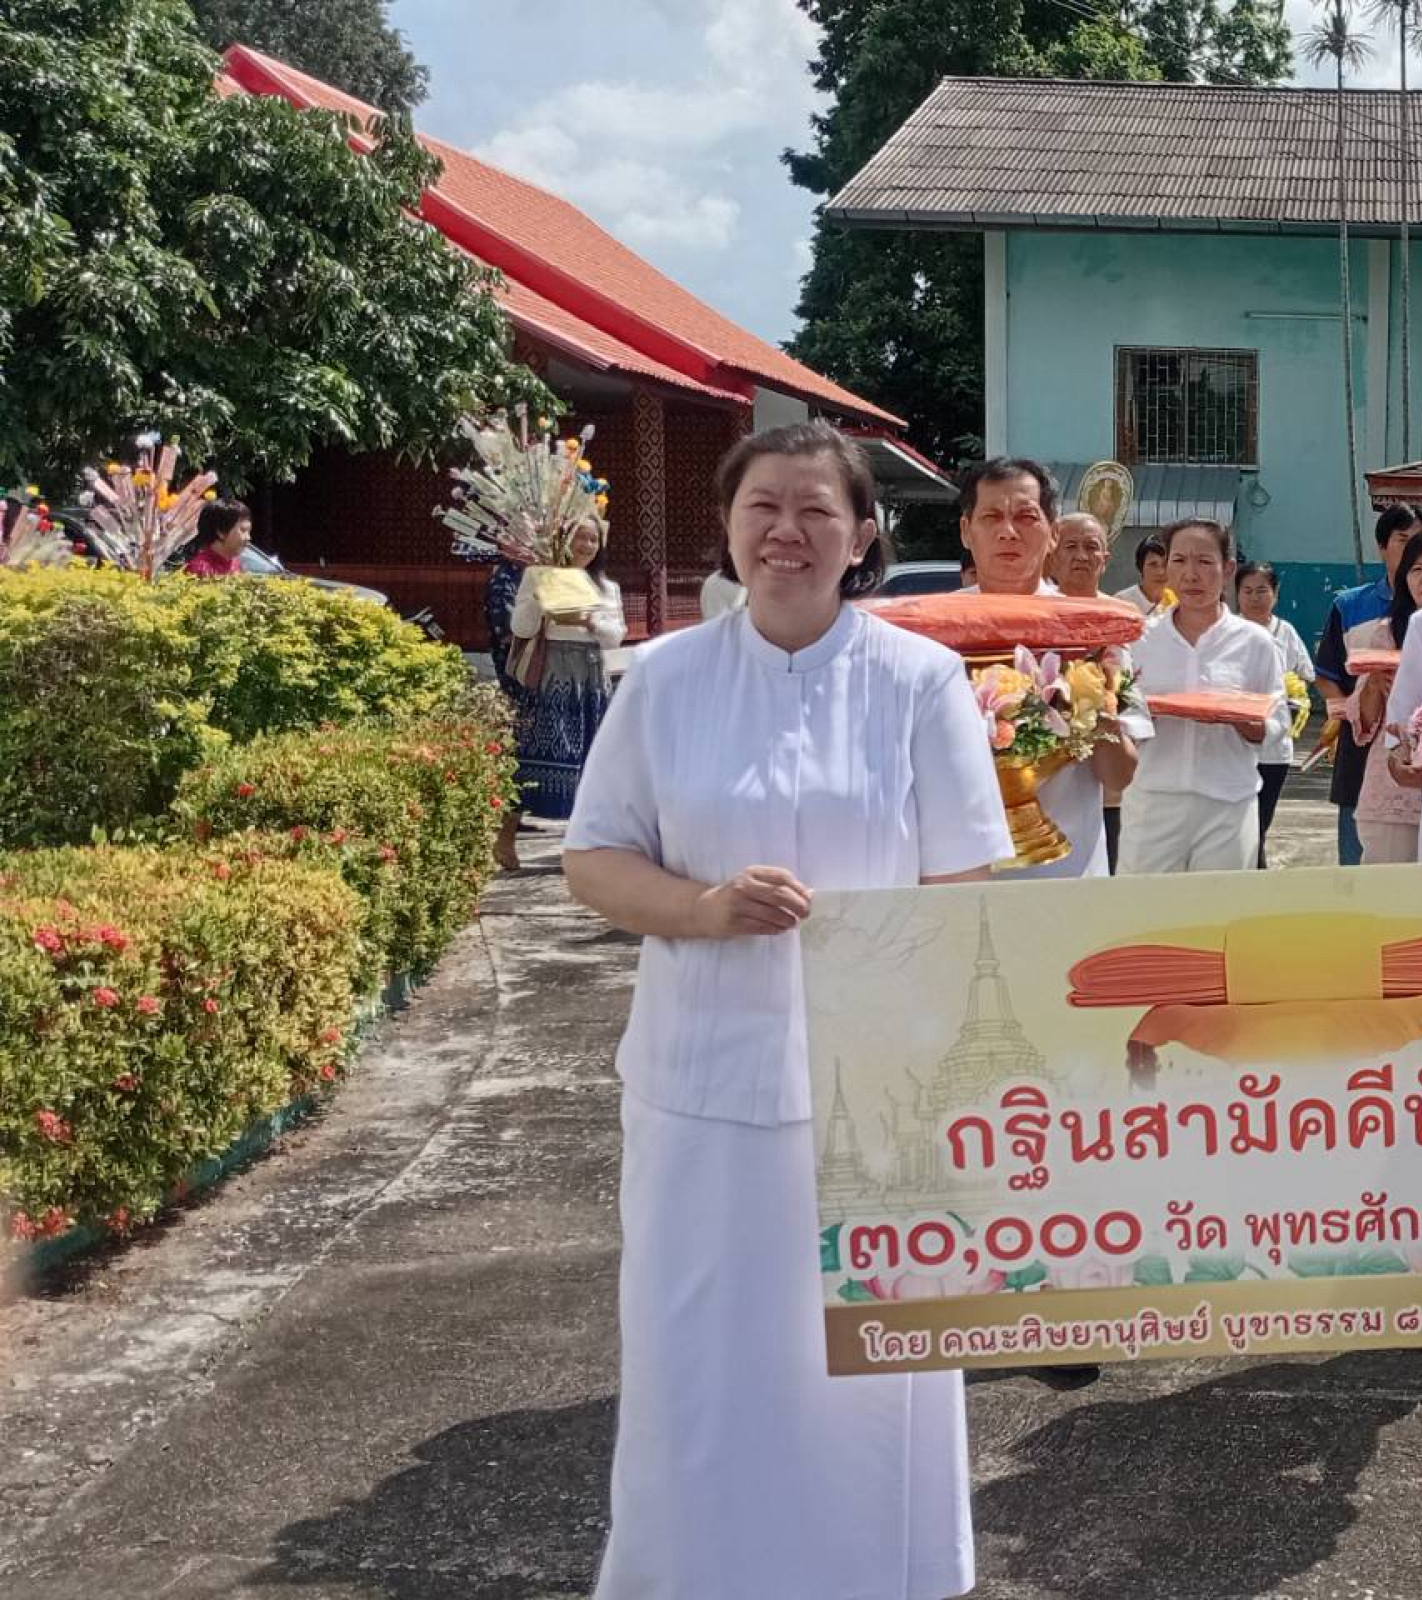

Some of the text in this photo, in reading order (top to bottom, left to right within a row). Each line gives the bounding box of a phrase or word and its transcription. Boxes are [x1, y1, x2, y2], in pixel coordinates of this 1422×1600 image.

[848, 1210, 1143, 1275] ๓๐,๐๐๐
[1166, 1200, 1228, 1250] วัด
[864, 1325, 928, 1358] โดย
[942, 1305, 1208, 1356] คณะศิษยานุศิษย์
[1223, 1307, 1382, 1350] บูชาธรรม
